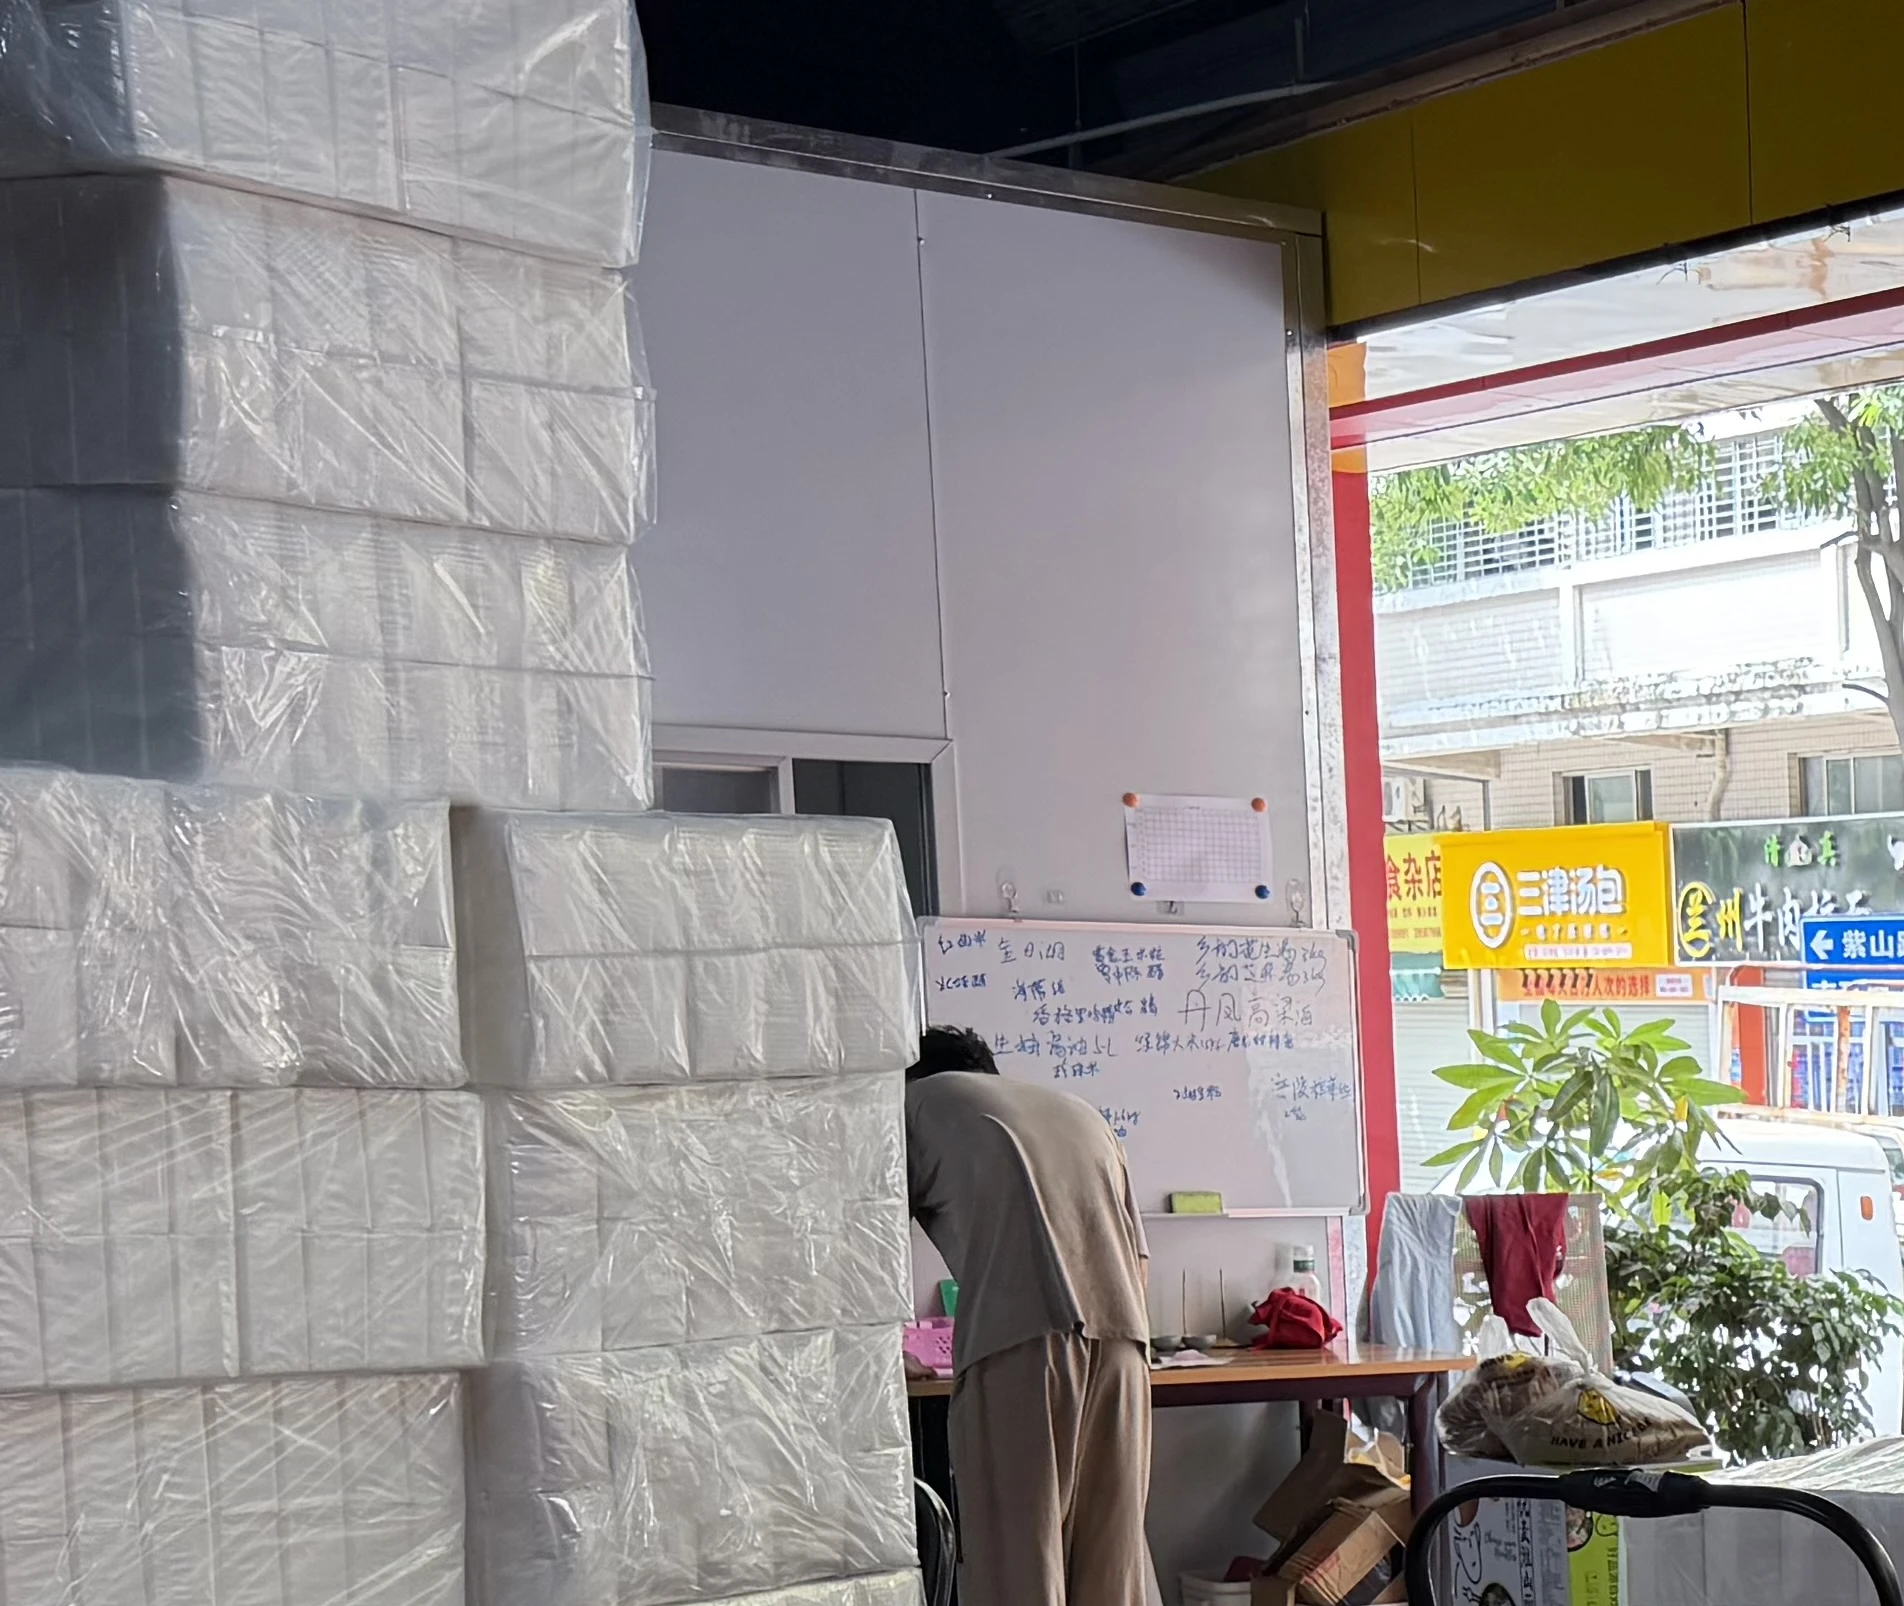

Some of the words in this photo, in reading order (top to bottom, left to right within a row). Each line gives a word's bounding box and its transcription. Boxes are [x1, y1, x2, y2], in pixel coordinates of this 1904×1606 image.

[1516, 864, 1624, 916] 三津汤包
[1551, 1434, 1586, 1449] HAVE
